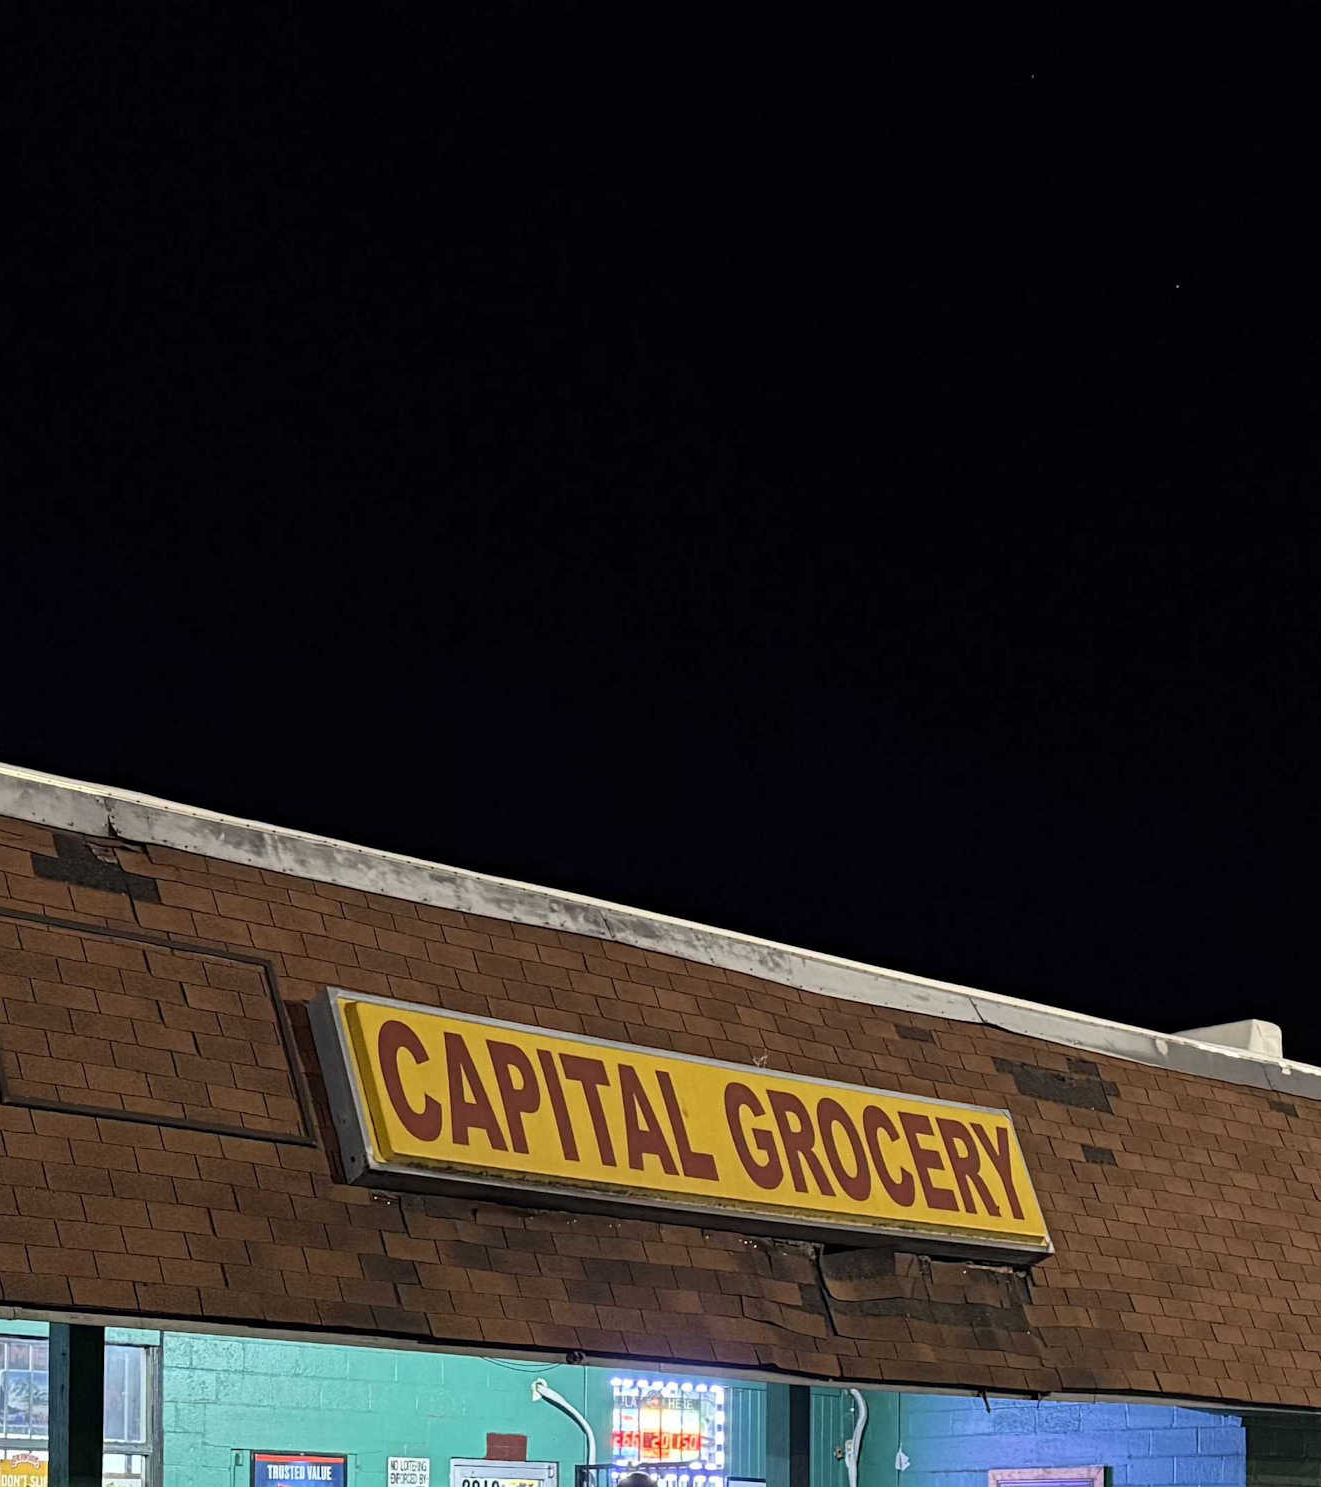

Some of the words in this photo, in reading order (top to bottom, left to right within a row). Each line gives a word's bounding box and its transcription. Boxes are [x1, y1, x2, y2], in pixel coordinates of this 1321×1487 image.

[378, 1020, 718, 1182] CAPITAL
[724, 1081, 1025, 1221] GROCERY
[267, 1464, 305, 1480] TRUSTED
[307, 1465, 332, 1481] VALUE
